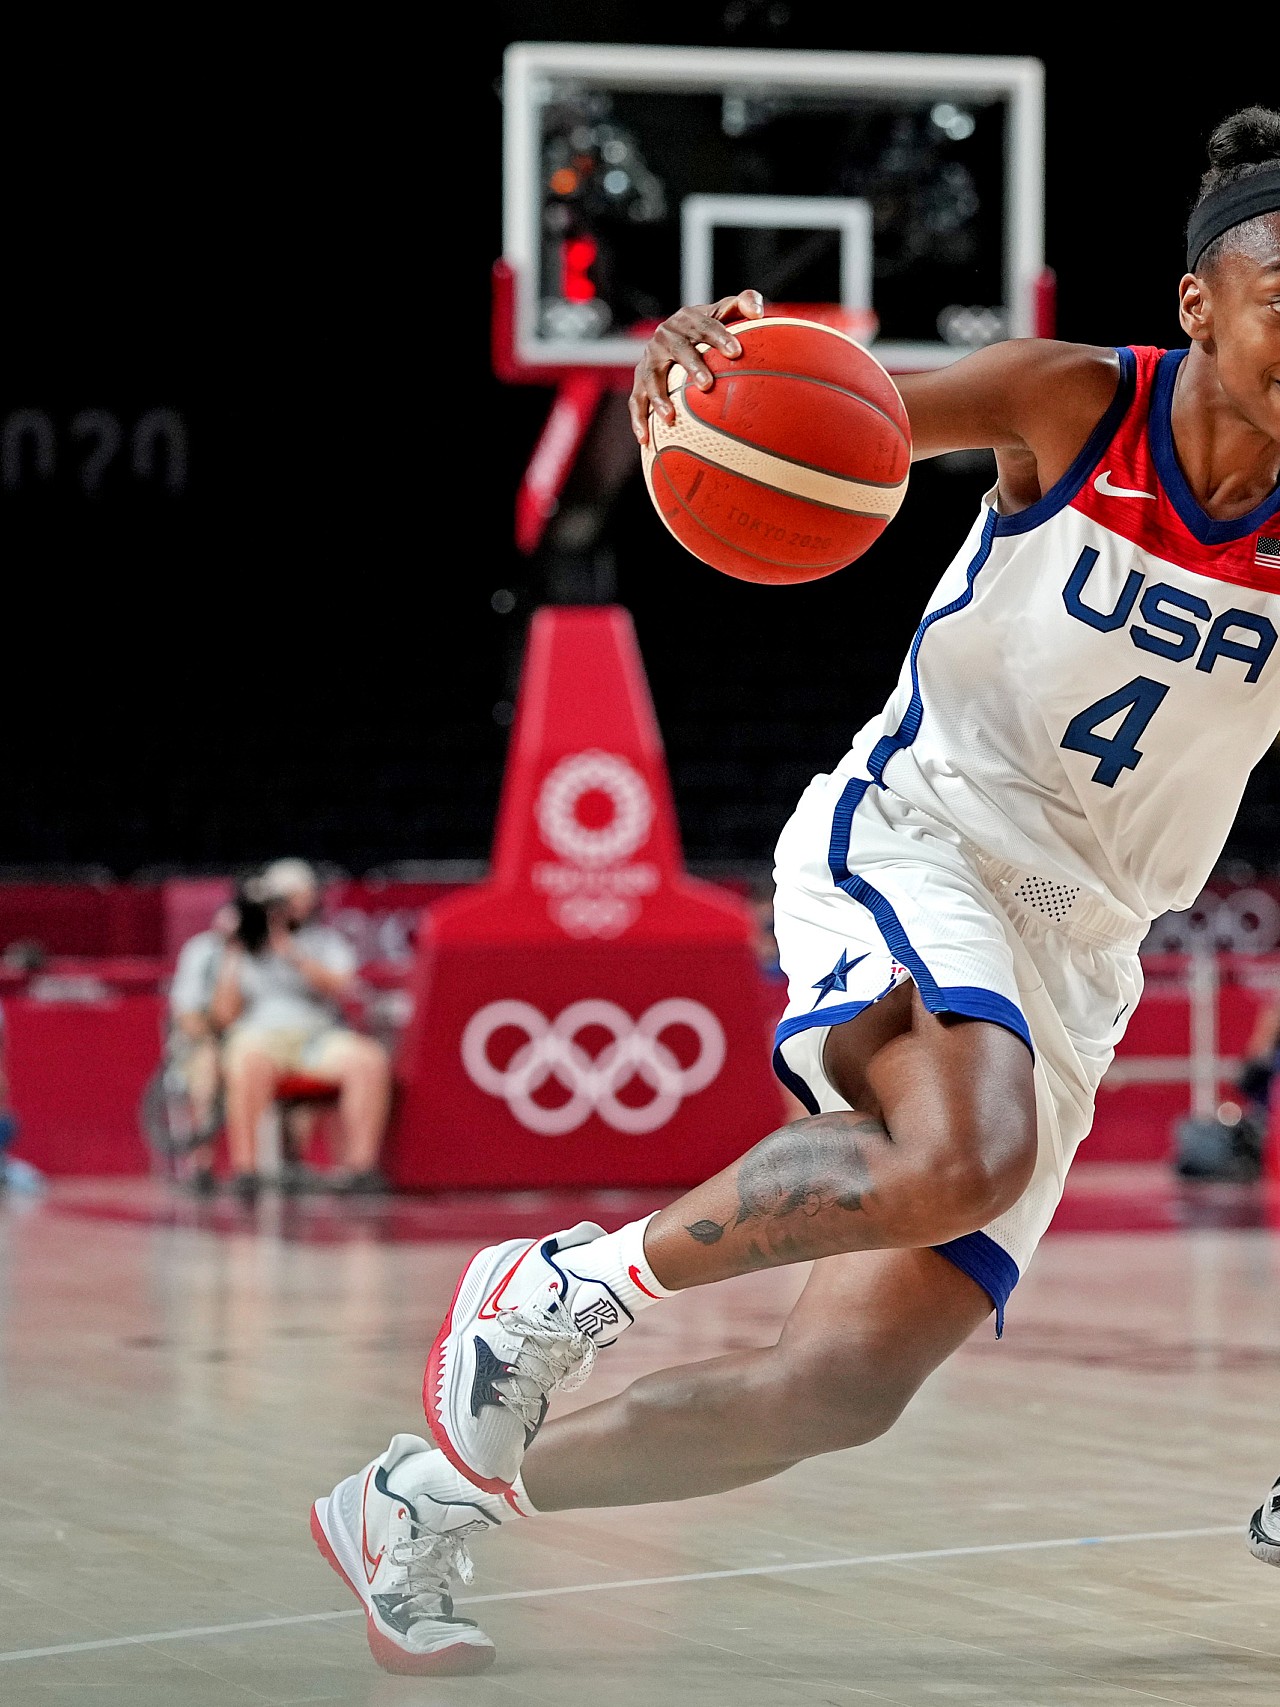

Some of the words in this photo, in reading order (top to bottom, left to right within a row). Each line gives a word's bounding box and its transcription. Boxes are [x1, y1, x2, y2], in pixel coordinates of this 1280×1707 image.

[727, 507, 786, 541] TOKYO
[790, 533, 833, 550] 2020
[1062, 545, 1279, 684] USA
[1060, 675, 1171, 788] 4
